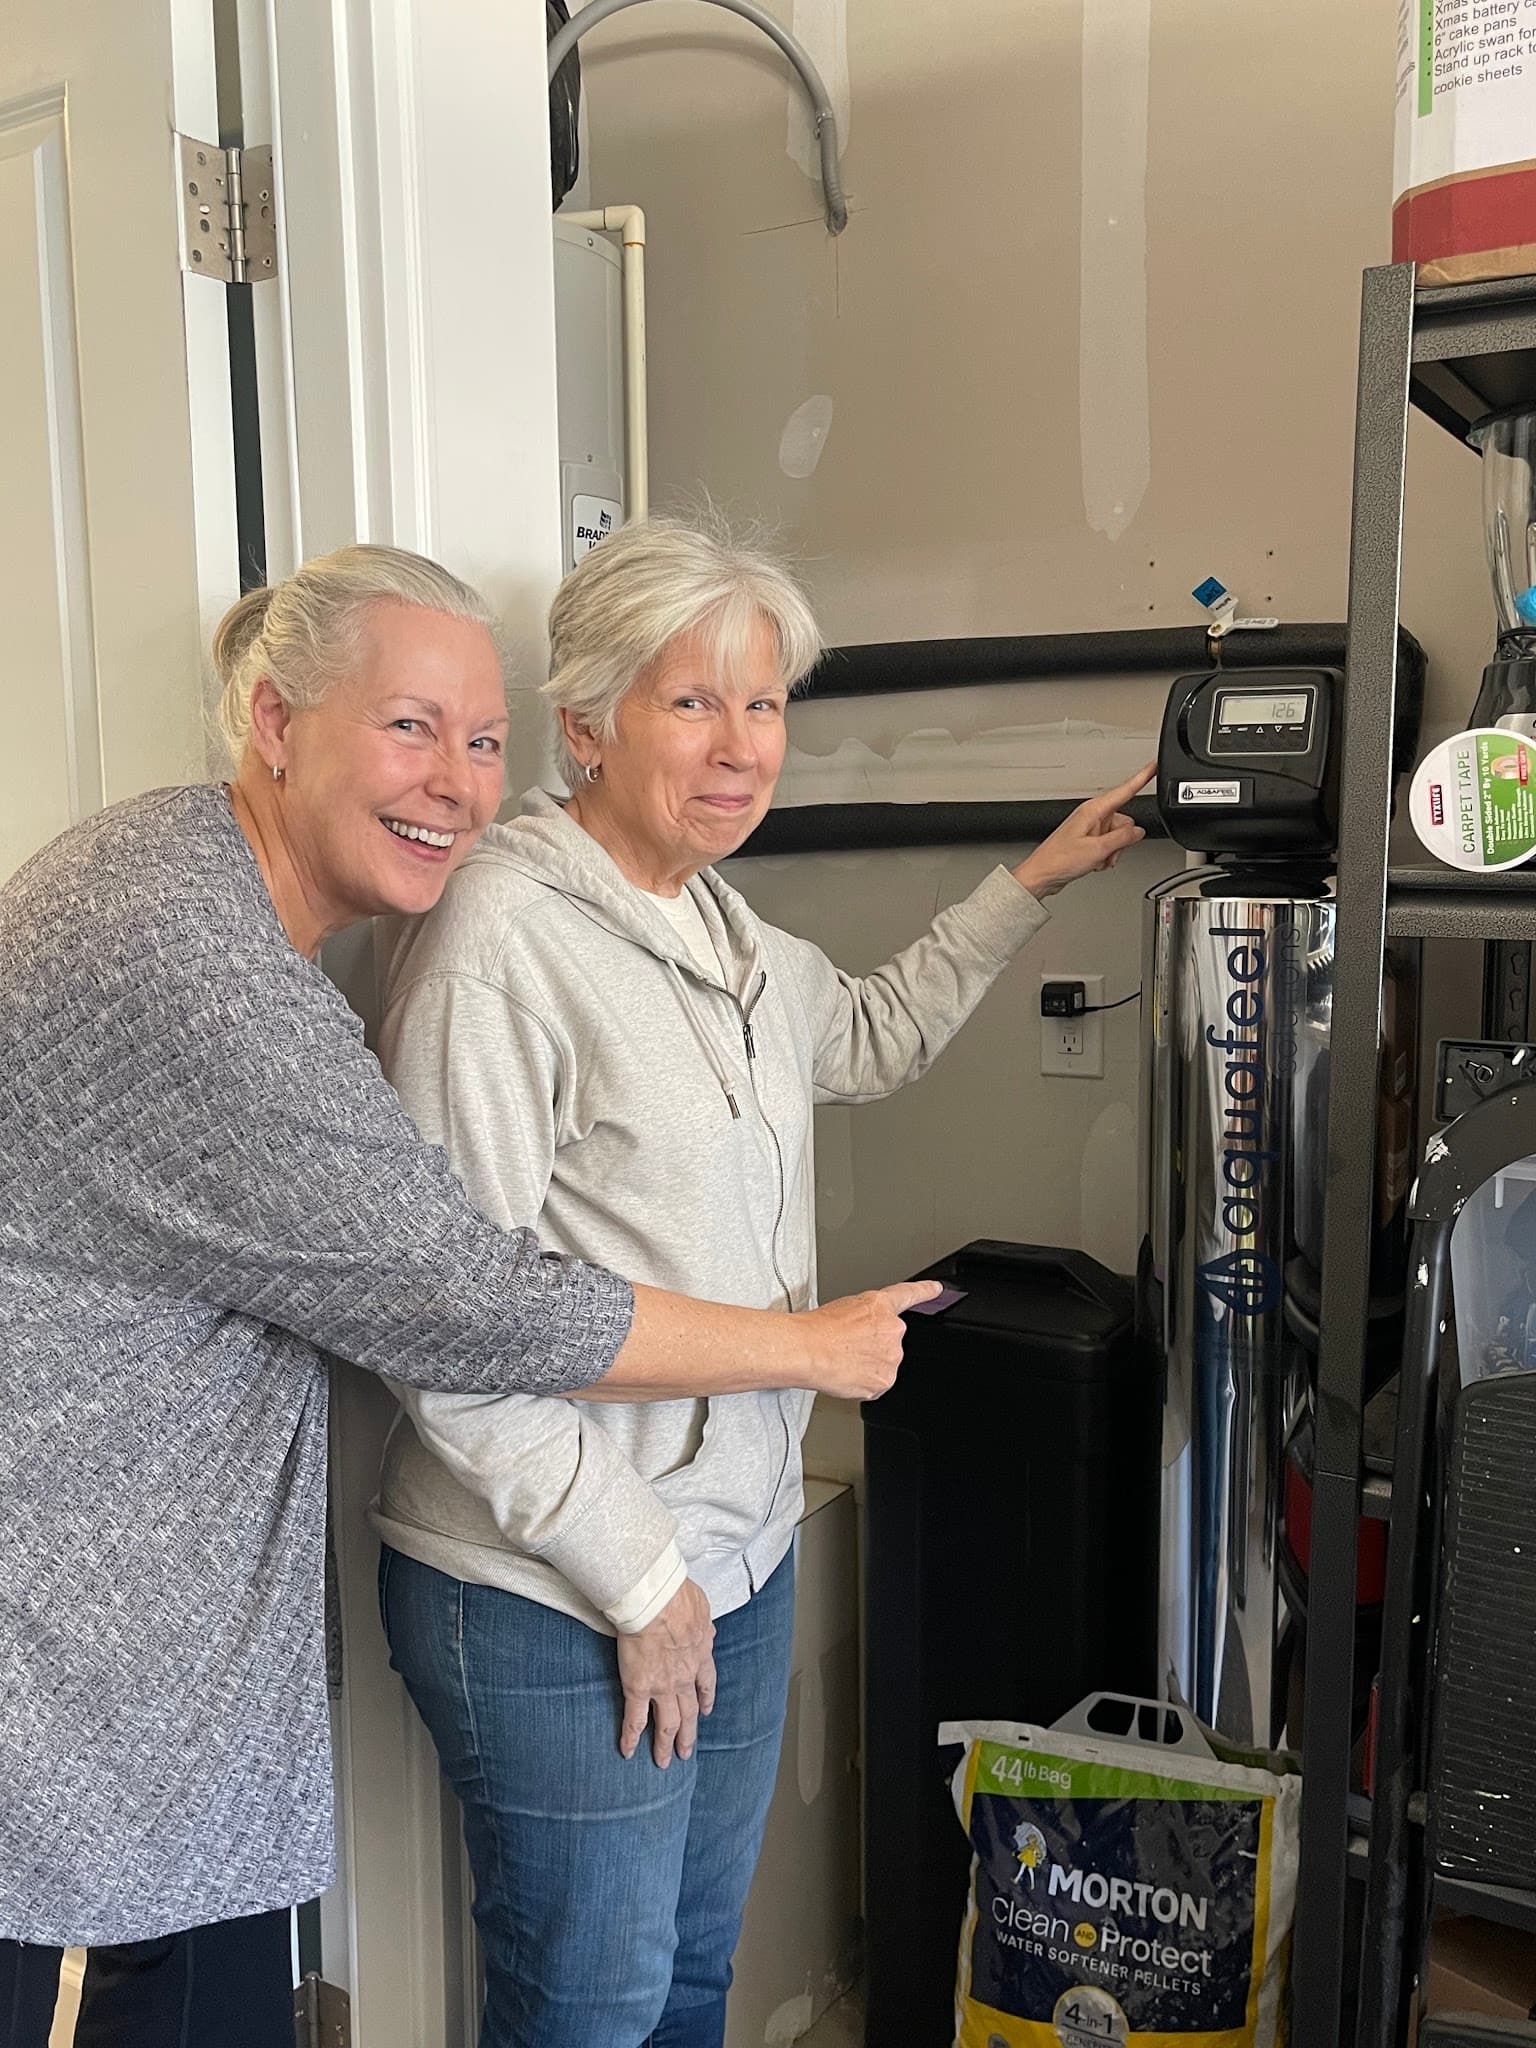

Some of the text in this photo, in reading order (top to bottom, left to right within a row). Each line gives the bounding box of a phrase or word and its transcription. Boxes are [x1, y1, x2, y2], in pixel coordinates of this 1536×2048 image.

[1435, 0, 1468, 16] Xmas
[1435, 12, 1468, 32] Xmas
[1473, 1, 1520, 19] battery
[1434, 27, 1536, 62] Acrylic swan for
[1435, 17, 1517, 47] 6" cake pans
[1434, 55, 1468, 77] Stand
[1473, 53, 1490, 67] up
[1494, 44, 1523, 61] rack
[1434, 64, 1523, 95] cookie sheets
[576, 526, 609, 541] BRAD
[1272, 702, 1295, 718] 126
[1480, 741, 1489, 765] Yards
[1482, 766, 1489, 776] 10
[1483, 778, 1491, 789] By
[1457, 750, 1476, 853] CARPET TAPE
[1484, 801, 1493, 825] Sided
[1485, 826, 1495, 855] Double
[1206, 927, 1279, 1236] aquafeel
[1038, 1765, 1072, 1789] Bag
[1049, 1864, 1209, 1931] MORTON
[991, 1896, 1213, 1977] Clean AND Protect
[996, 1928, 1201, 1996] WATER SOFTENER PELLETS
